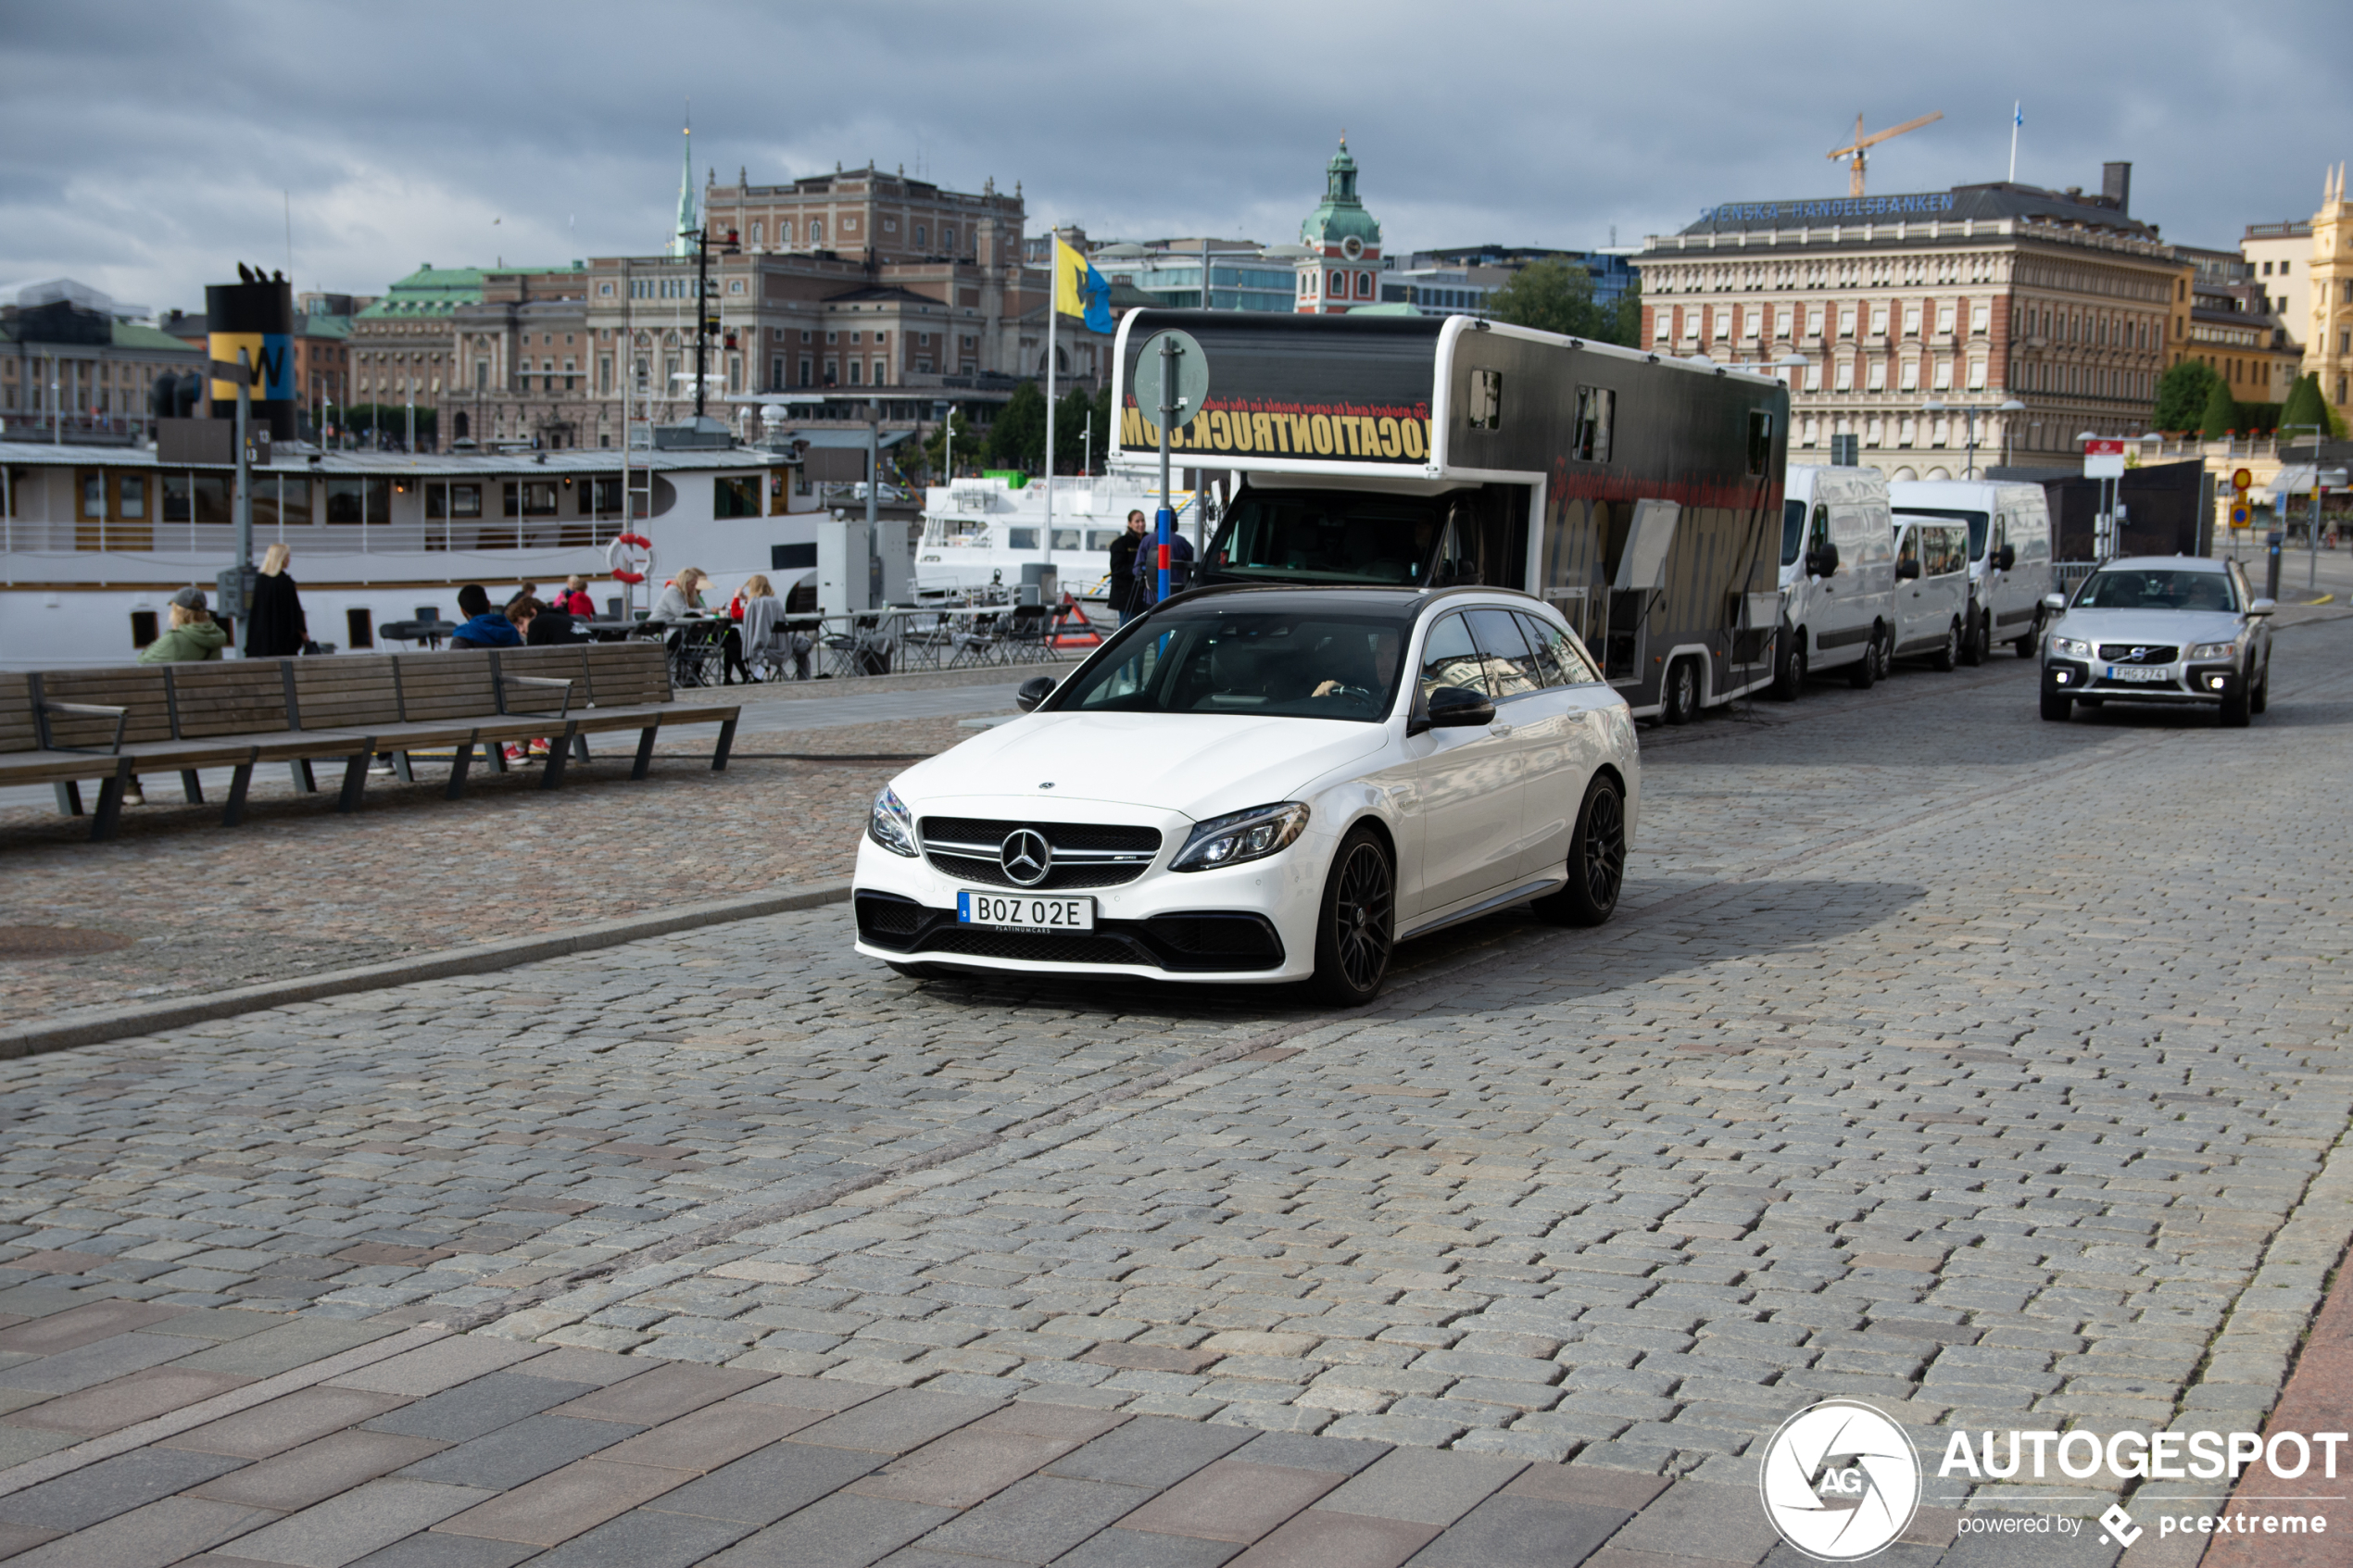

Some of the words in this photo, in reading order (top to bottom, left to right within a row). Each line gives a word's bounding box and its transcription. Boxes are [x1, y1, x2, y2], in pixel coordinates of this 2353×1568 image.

[1700, 204, 1779, 222] SVENSKA
[1792, 194, 1954, 218] HANDELSBANKEN
[239, 346, 285, 387] W
[2117, 669, 2138, 679] FHG
[2141, 669, 2162, 679] 274
[978, 897, 1023, 923] BOZ
[1032, 901, 1080, 926] 02E
[995, 925, 1051, 934] PLATINUMCARS
